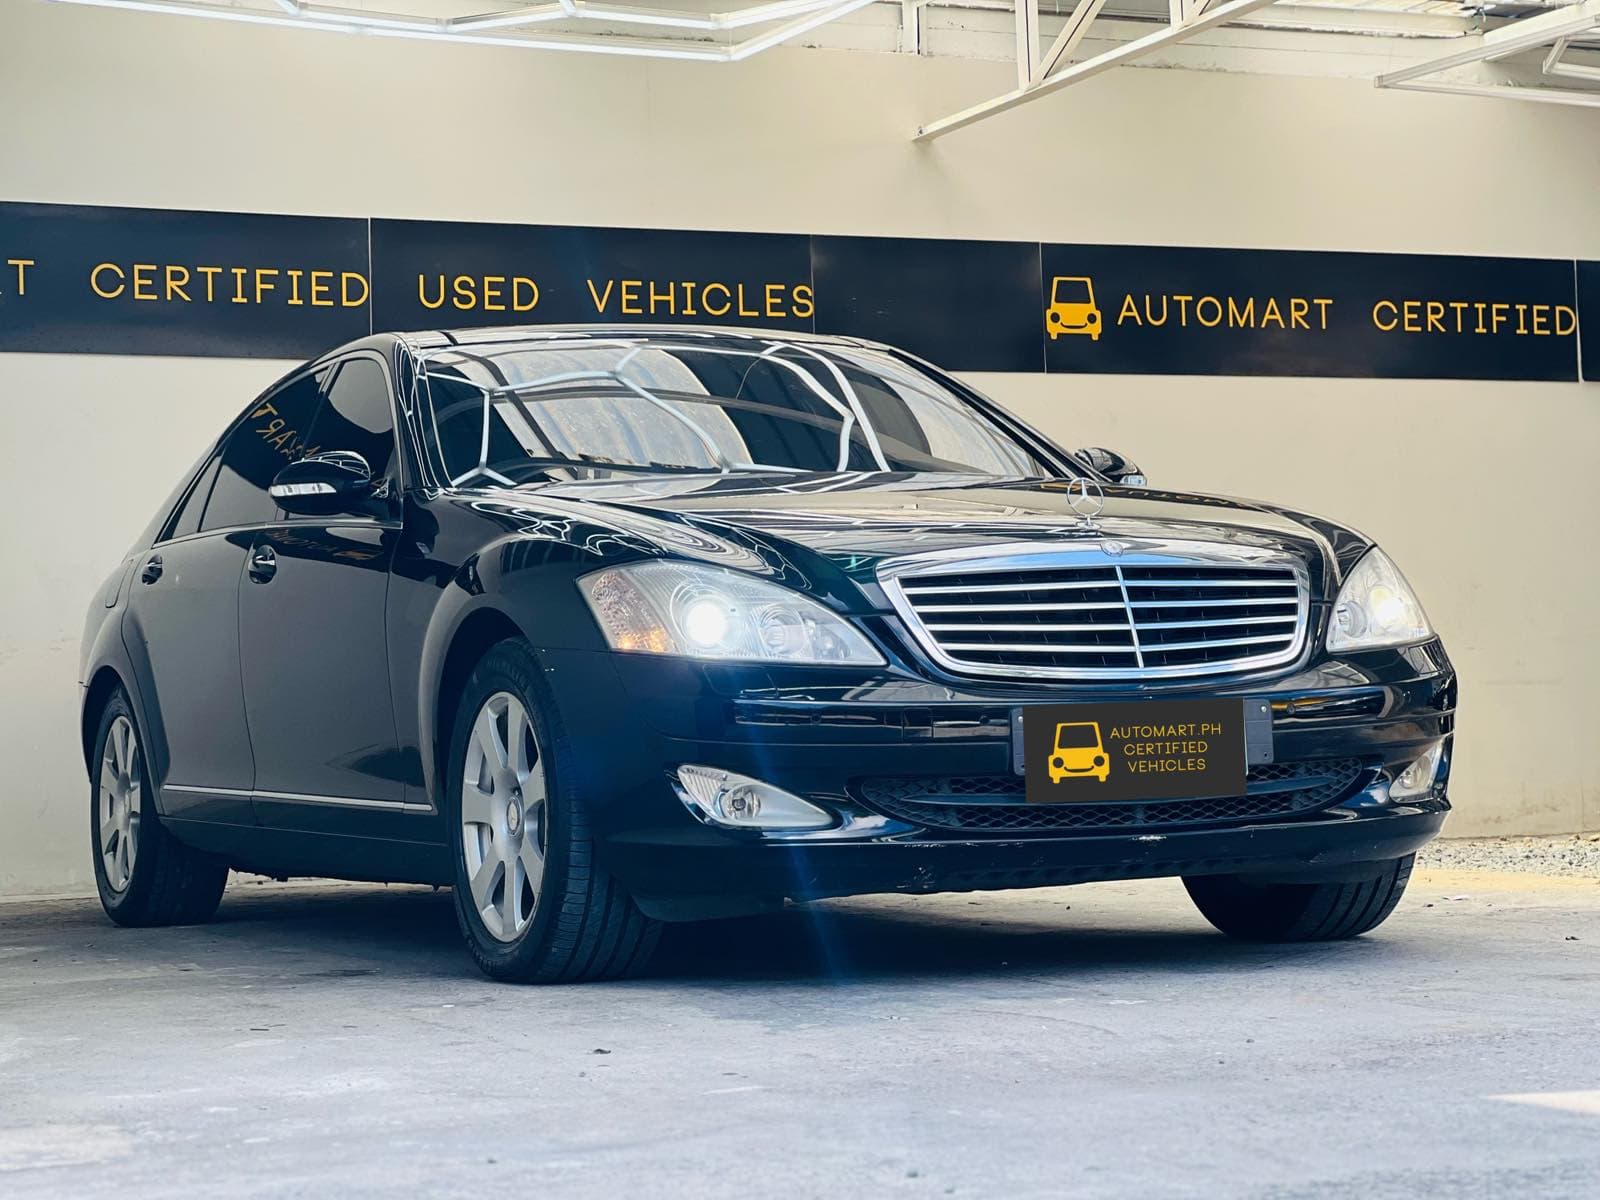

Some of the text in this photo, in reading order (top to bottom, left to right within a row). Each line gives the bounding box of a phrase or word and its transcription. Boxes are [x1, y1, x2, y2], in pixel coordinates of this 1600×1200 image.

[0, 259, 816, 319] T CERTIFIED USED VEHICLES
[1117, 294, 1578, 337] AUTOMART CERTIFIED
